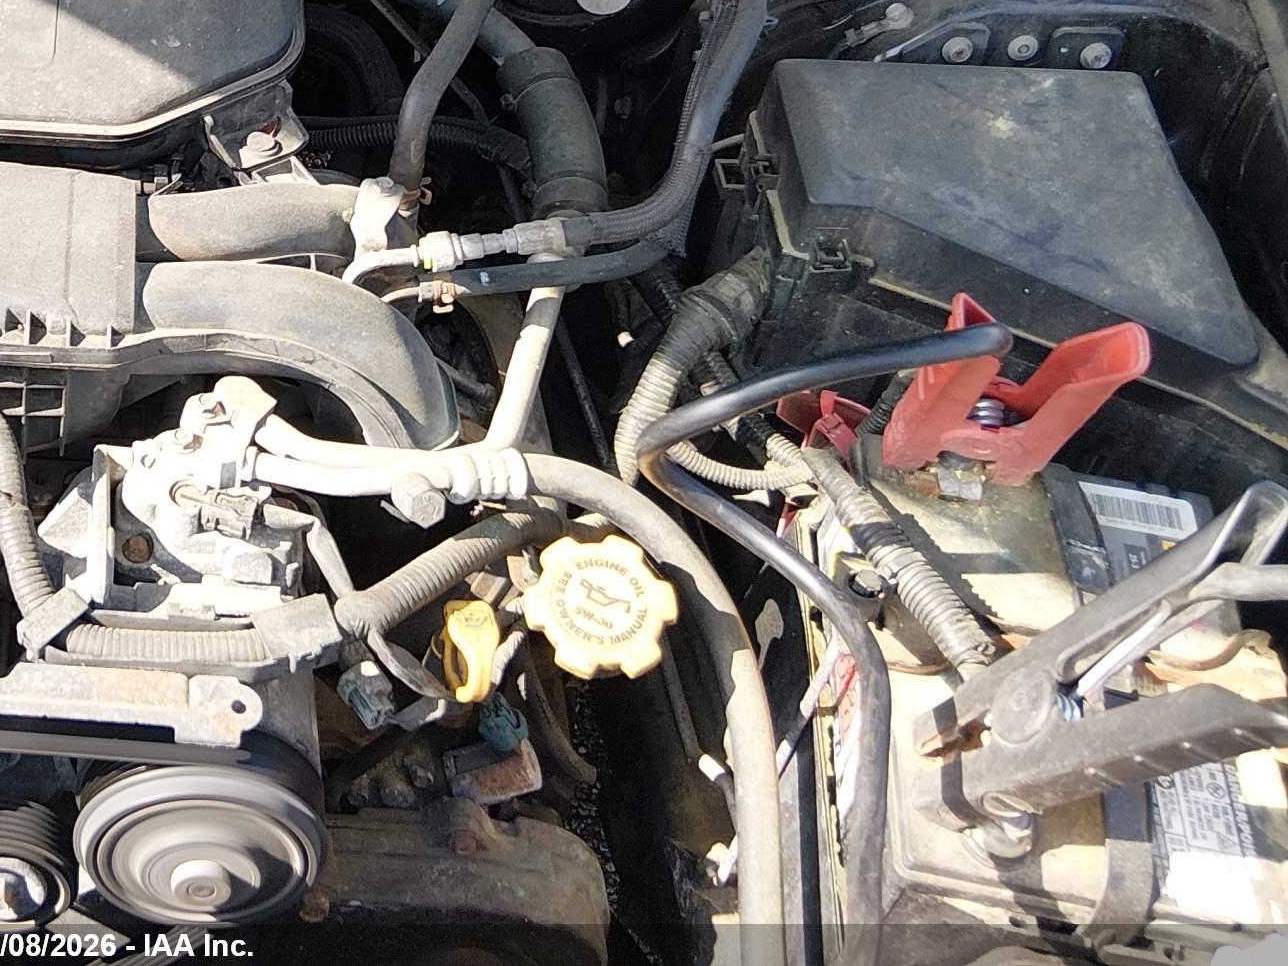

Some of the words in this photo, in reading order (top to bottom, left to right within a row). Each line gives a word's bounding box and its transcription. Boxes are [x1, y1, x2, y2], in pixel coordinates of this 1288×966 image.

[556, 572, 573, 594] SEE
[576, 559, 627, 576] ENGINE
[630, 578, 645, 598] OIL
[556, 599, 605, 645] OWNER'S
[574, 606, 614, 630] 5W-30
[608, 607, 648, 645] MANUAL
